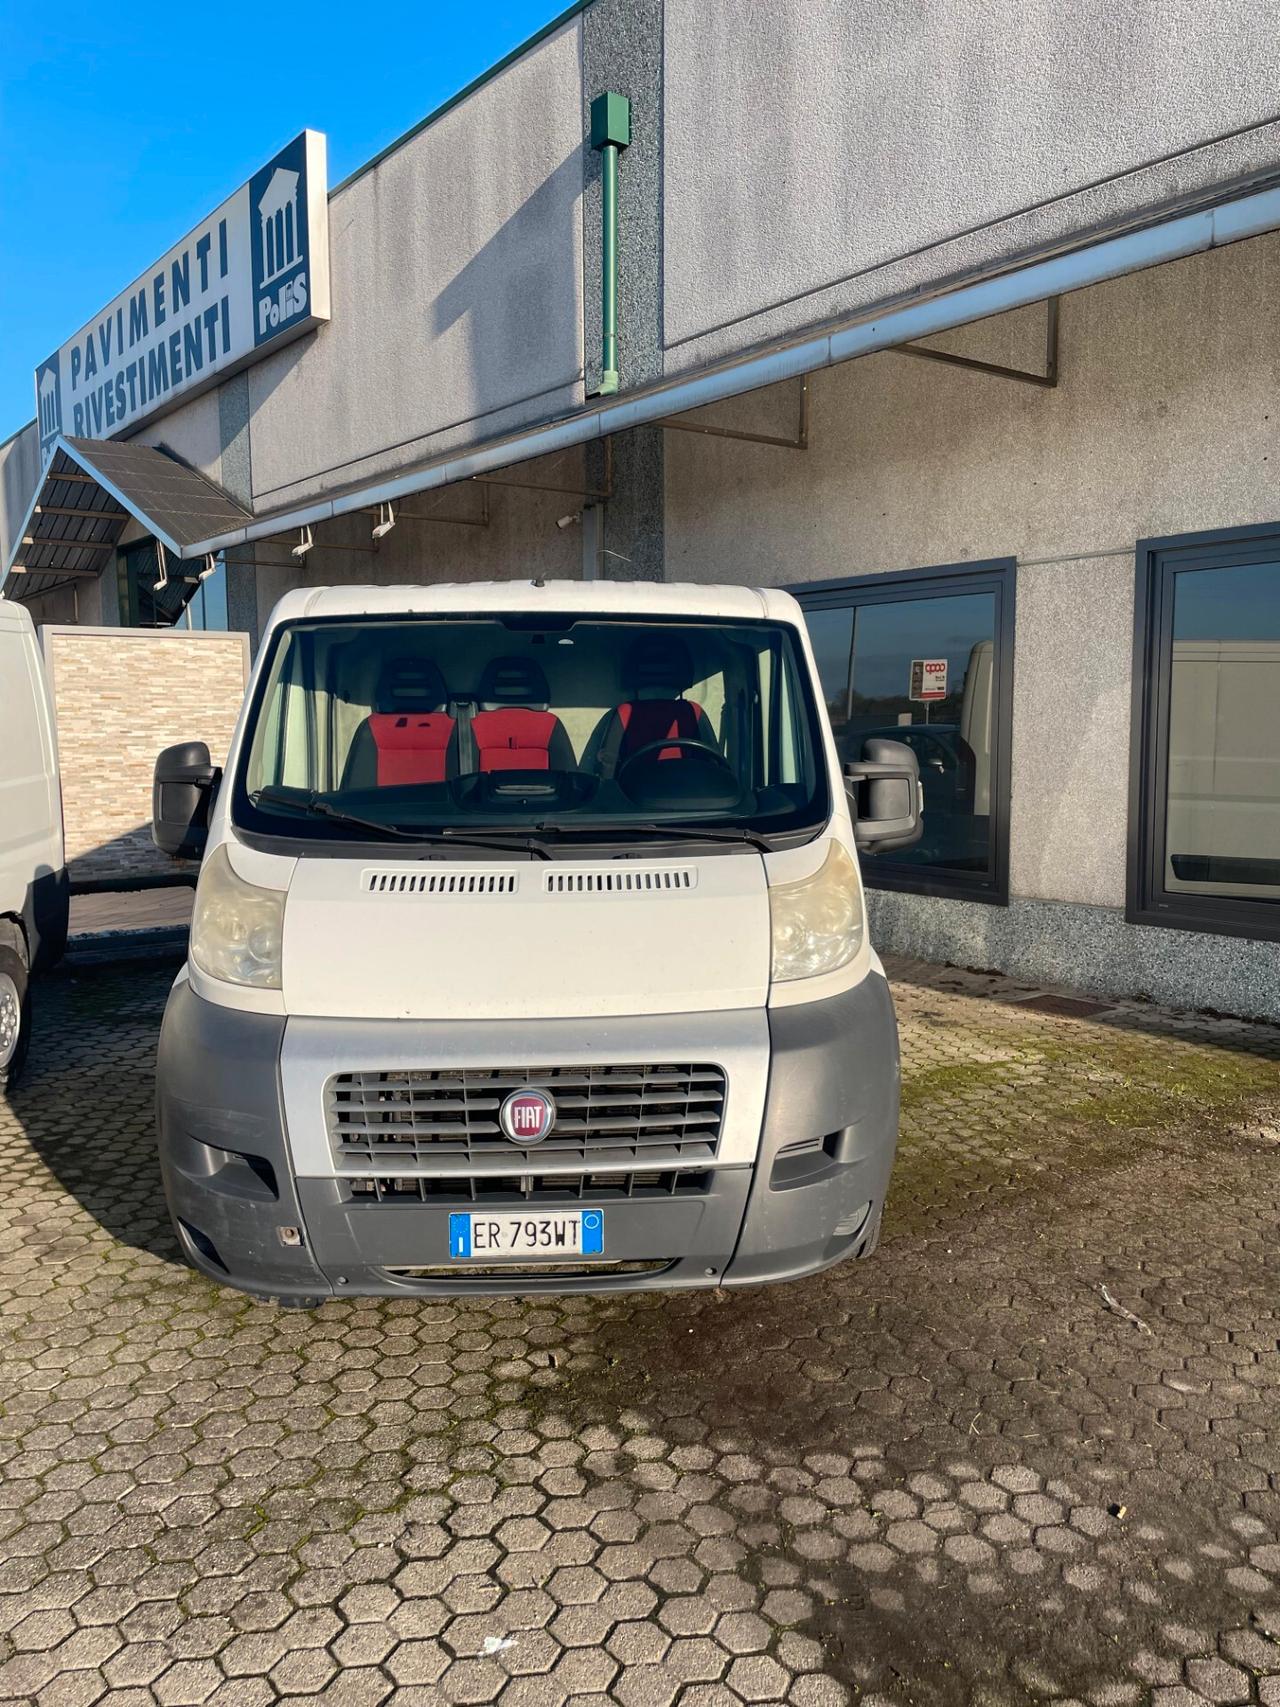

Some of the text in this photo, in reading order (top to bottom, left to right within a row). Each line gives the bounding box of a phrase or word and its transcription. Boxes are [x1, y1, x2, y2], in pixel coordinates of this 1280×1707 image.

[71, 218, 229, 391] PAVIMENTI
[73, 295, 231, 438] RIVESTIMENTI
[514, 1106, 542, 1128] FIAT
[474, 1222, 501, 1249] ER
